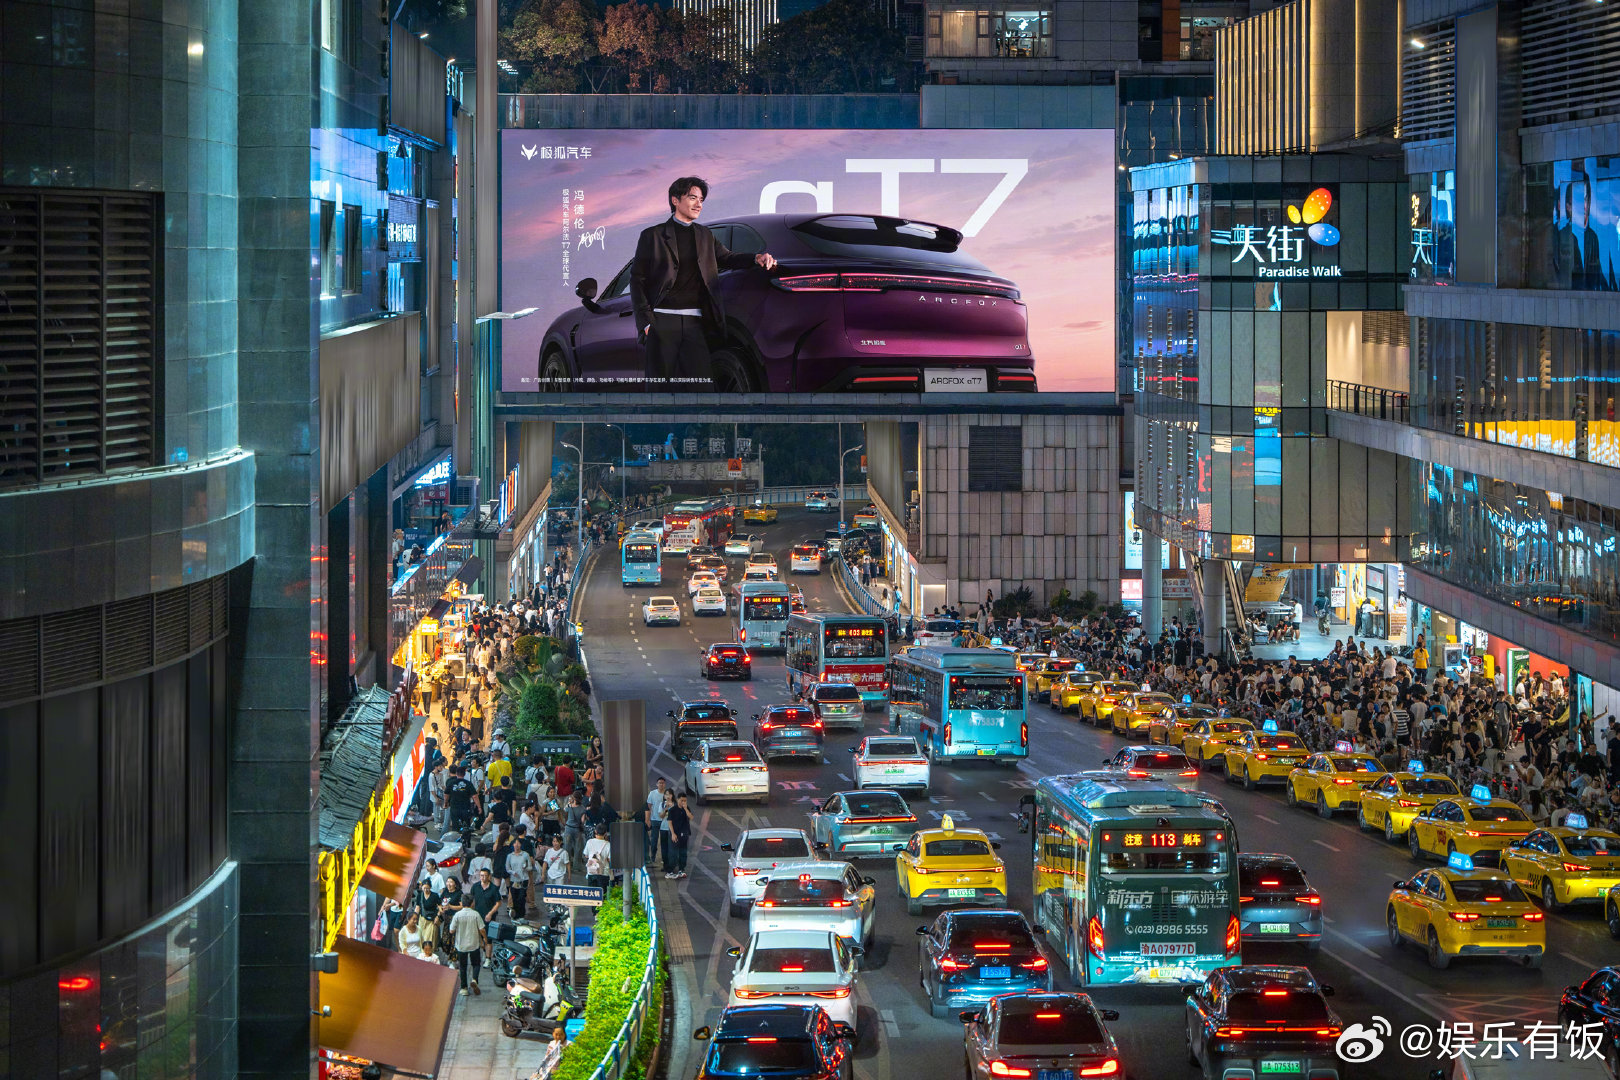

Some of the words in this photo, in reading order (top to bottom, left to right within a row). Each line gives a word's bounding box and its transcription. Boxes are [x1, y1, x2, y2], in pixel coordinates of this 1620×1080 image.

[540, 146, 592, 160] 极狐汽车
[573, 190, 585, 229] 冯德伦
[1231, 225, 1304, 263] 天街
[1259, 266, 1309, 277] Paradise
[1312, 266, 1342, 277] Walk
[918, 295, 997, 306] ARCFOX
[930, 377, 964, 385] ARCFOX
[967, 377, 982, 385] αT7
[861, 673, 883, 682] 大闸蟹
[1124, 833, 1143, 846] 注意
[1151, 833, 1176, 846] 113
[1182, 833, 1201, 846] 刹车
[1107, 889, 1154, 908] 新东方
[1171, 890, 1229, 904] 国际游学
[1134, 925, 1155, 934] (023)
[1156, 924, 1183, 935] 8986
[1184, 924, 1209, 935] 5555
[1141, 944, 1195, 955] 渝A07977D
